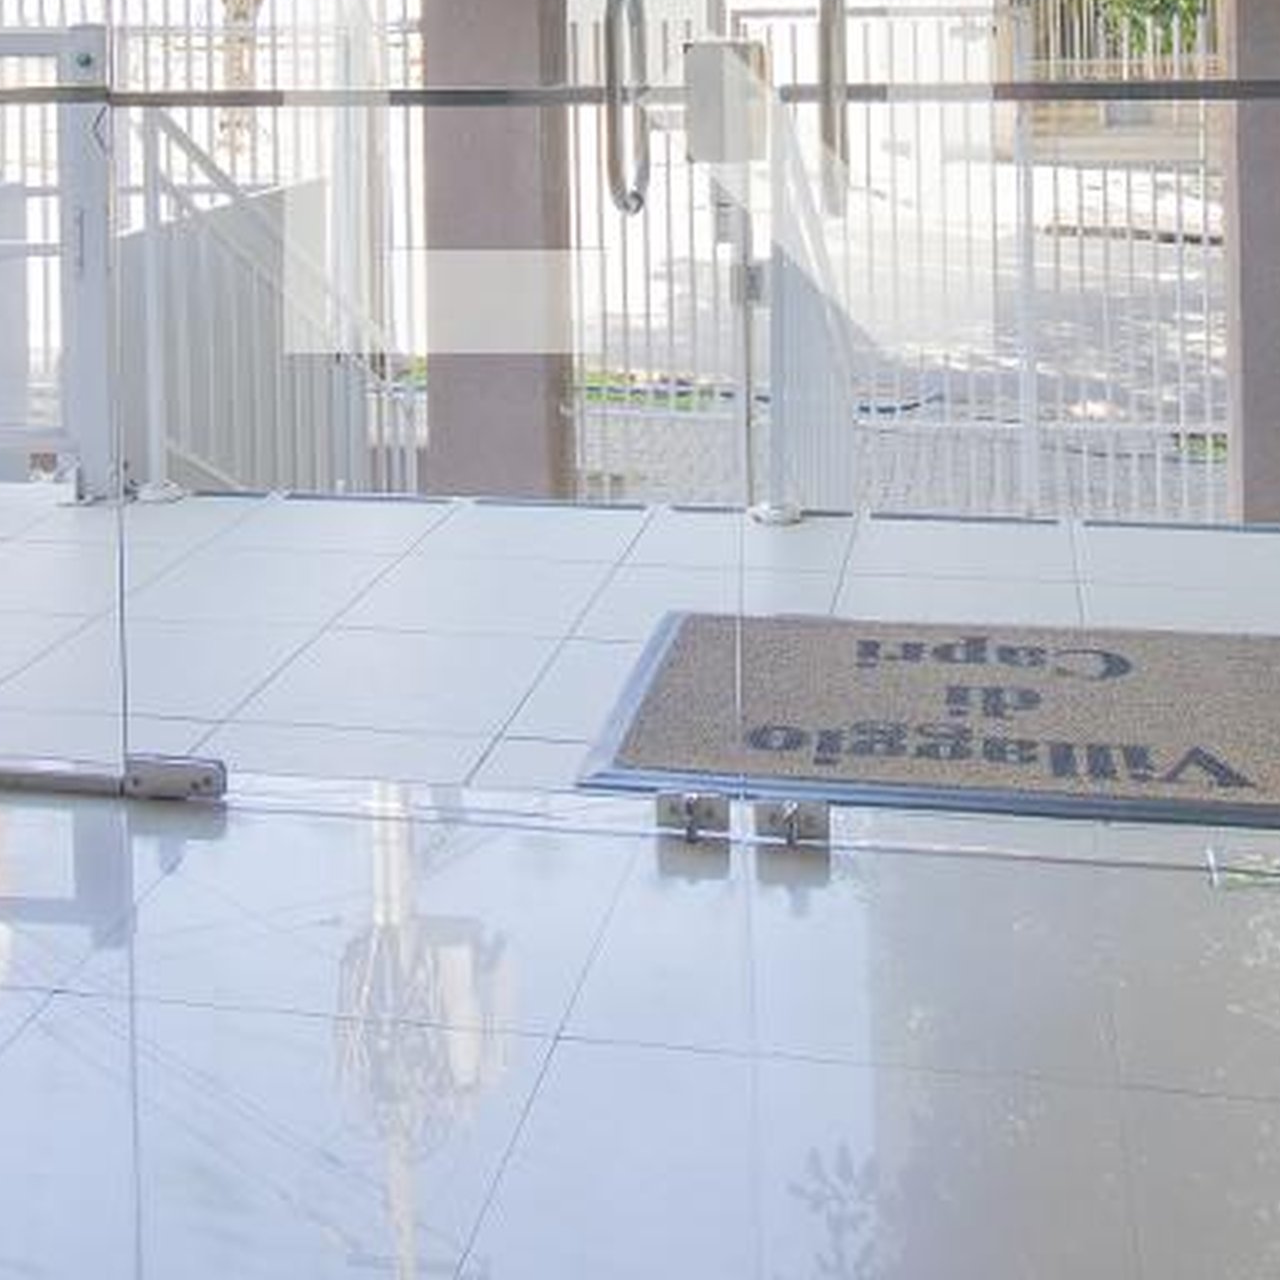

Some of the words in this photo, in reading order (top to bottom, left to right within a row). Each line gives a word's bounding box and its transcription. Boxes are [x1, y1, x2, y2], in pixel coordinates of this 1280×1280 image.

[855, 636, 1134, 682] Capri
[945, 685, 1042, 717] di
[746, 719, 1256, 789] Villaggio
